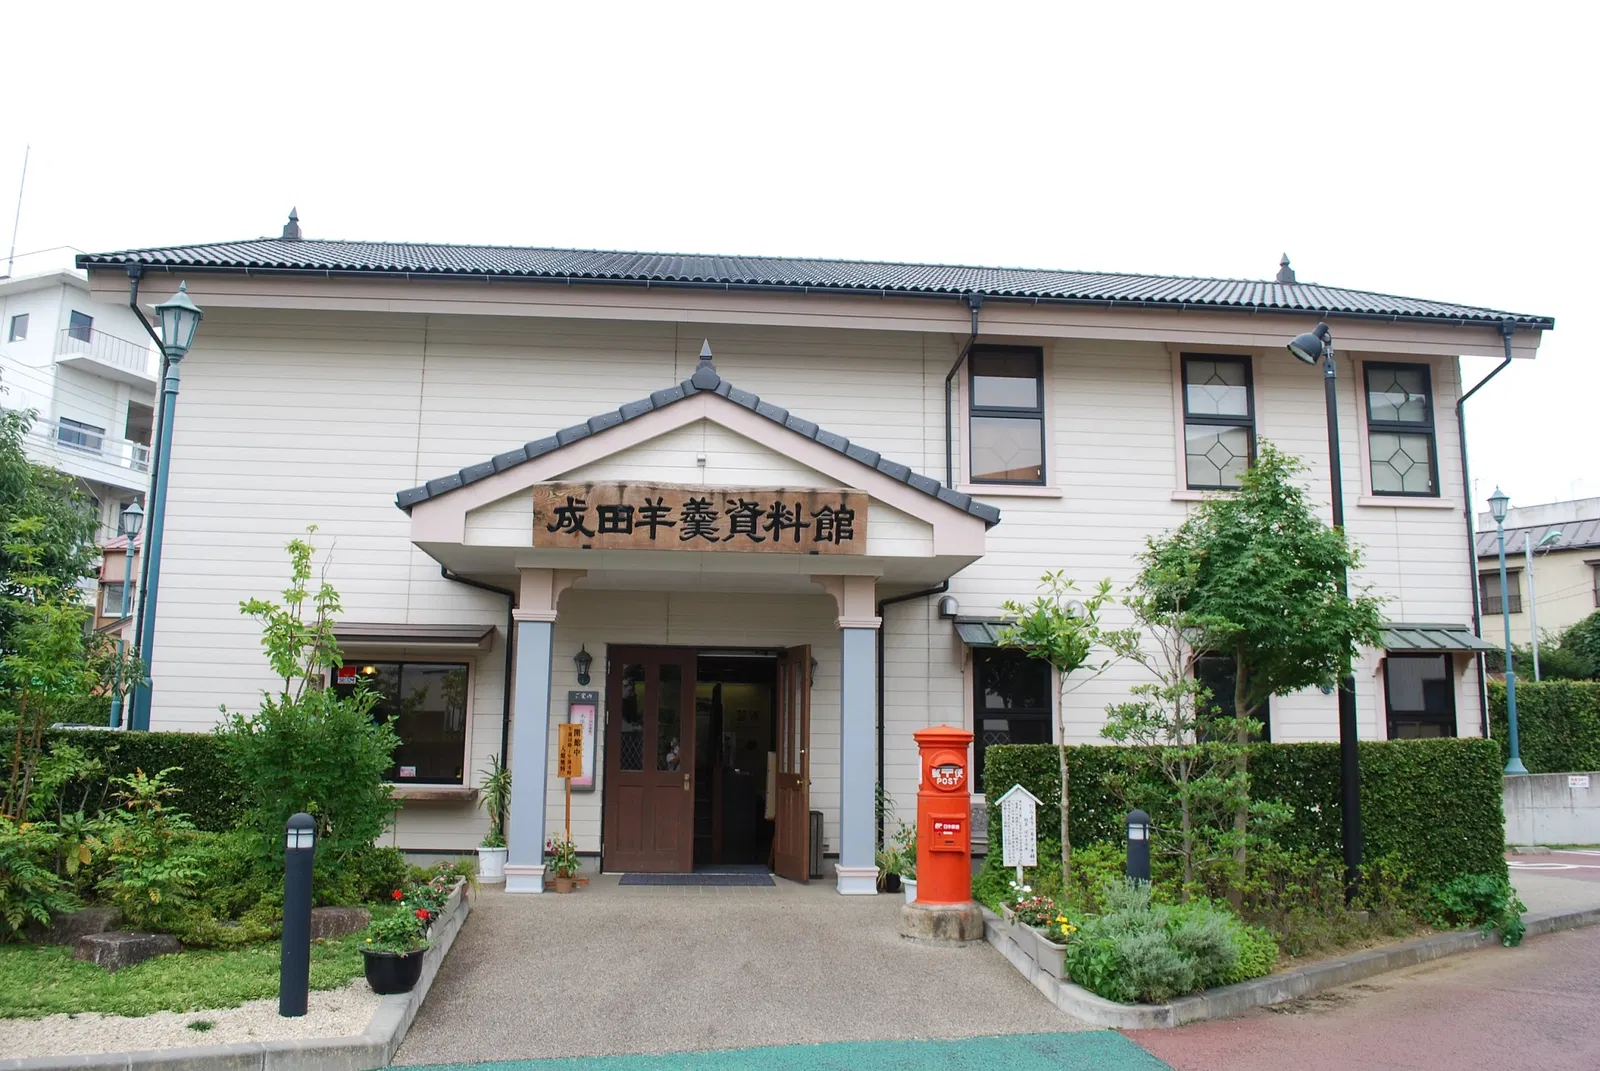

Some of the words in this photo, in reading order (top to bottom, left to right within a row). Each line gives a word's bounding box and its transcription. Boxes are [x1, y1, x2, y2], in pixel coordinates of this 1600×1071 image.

[546, 495, 855, 546] 成田羊羹資料館
[936, 777, 959, 785] POST
